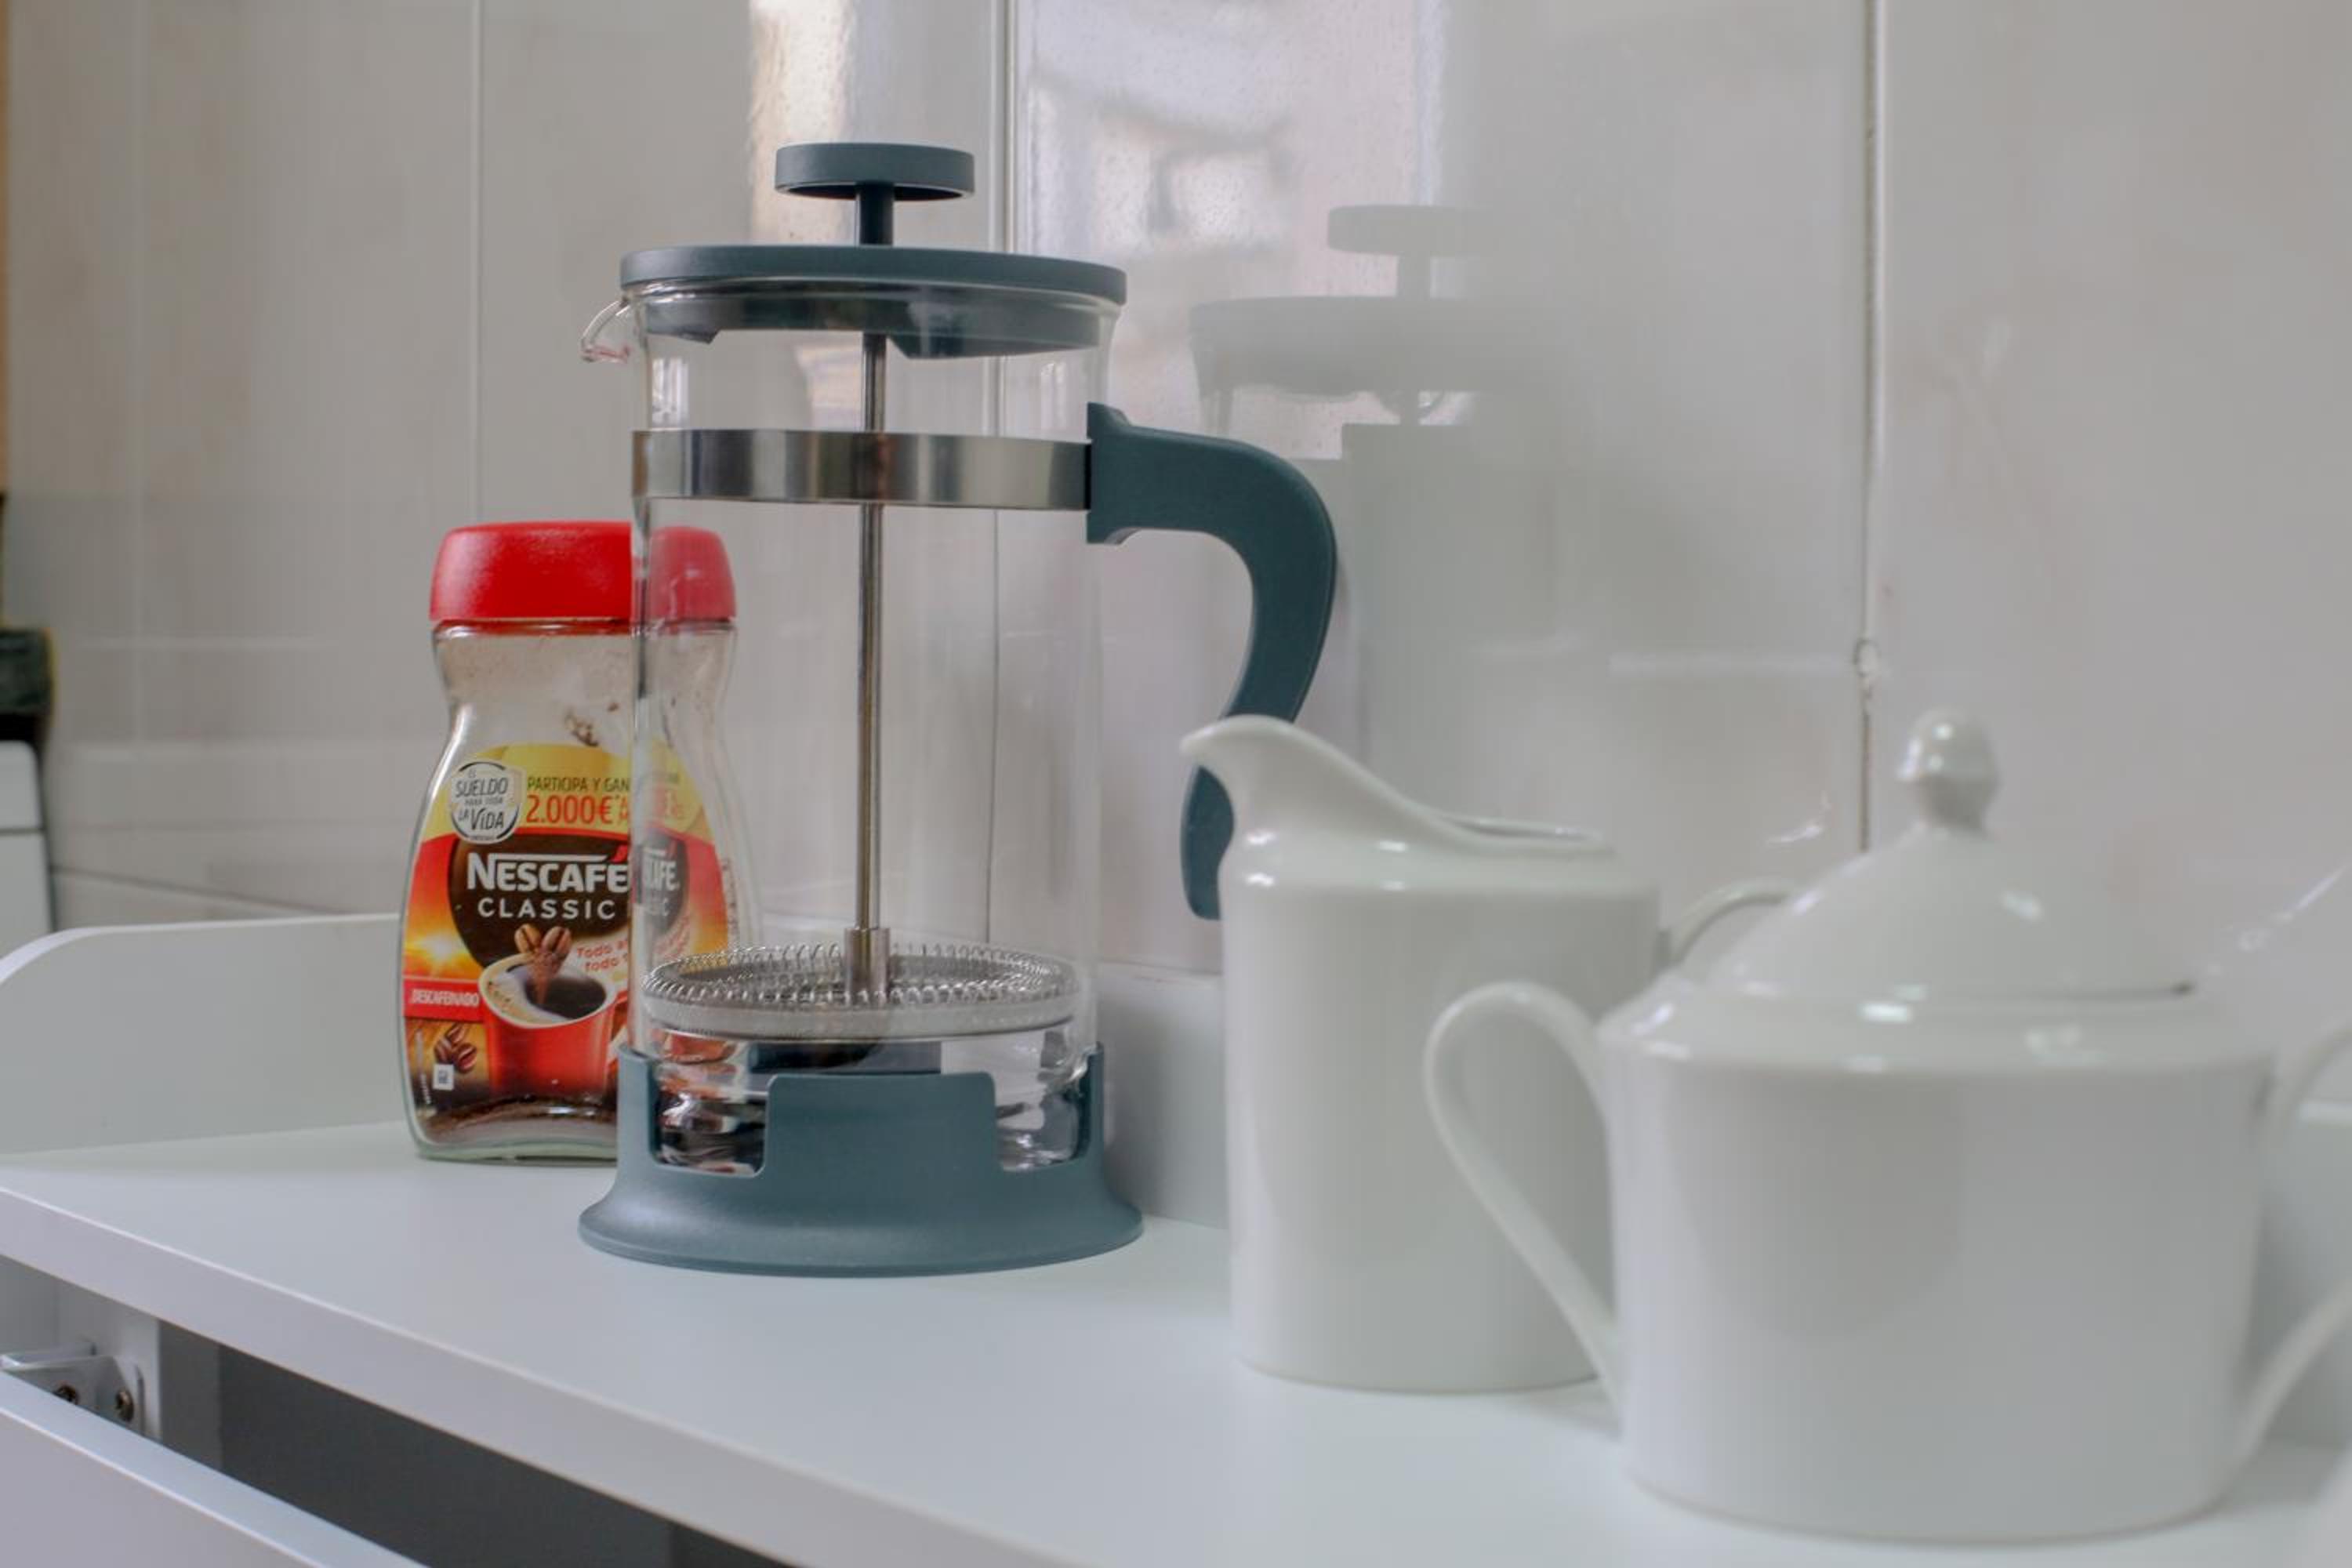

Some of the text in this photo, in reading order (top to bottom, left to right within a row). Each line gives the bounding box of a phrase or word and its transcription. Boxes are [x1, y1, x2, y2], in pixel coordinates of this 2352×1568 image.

[455, 777, 509, 798] SUELDO
[528, 778, 588, 791] PARTICIPA
[592, 778, 602, 790] Y
[604, 778, 631, 792] GAN
[477, 898, 615, 920] CLASSIC
